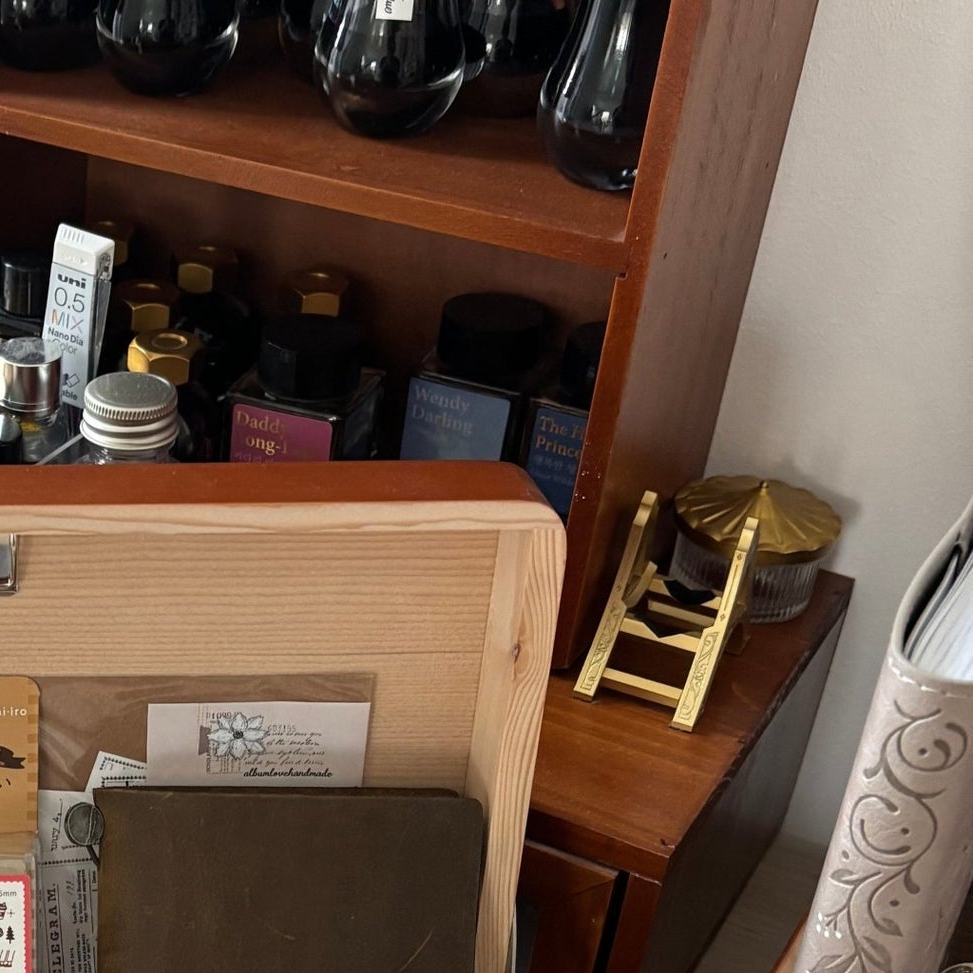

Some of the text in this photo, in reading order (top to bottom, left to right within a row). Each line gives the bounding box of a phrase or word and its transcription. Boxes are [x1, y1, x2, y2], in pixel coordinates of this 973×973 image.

[58, 273, 87, 290] uni
[54, 287, 85, 313] 0.5
[51, 309, 84, 334] MIX
[48, 327, 84, 347] Nano Dia
[414, 384, 470, 415] Wendy
[411, 404, 475, 436] Darling
[539, 415, 568, 436] The
